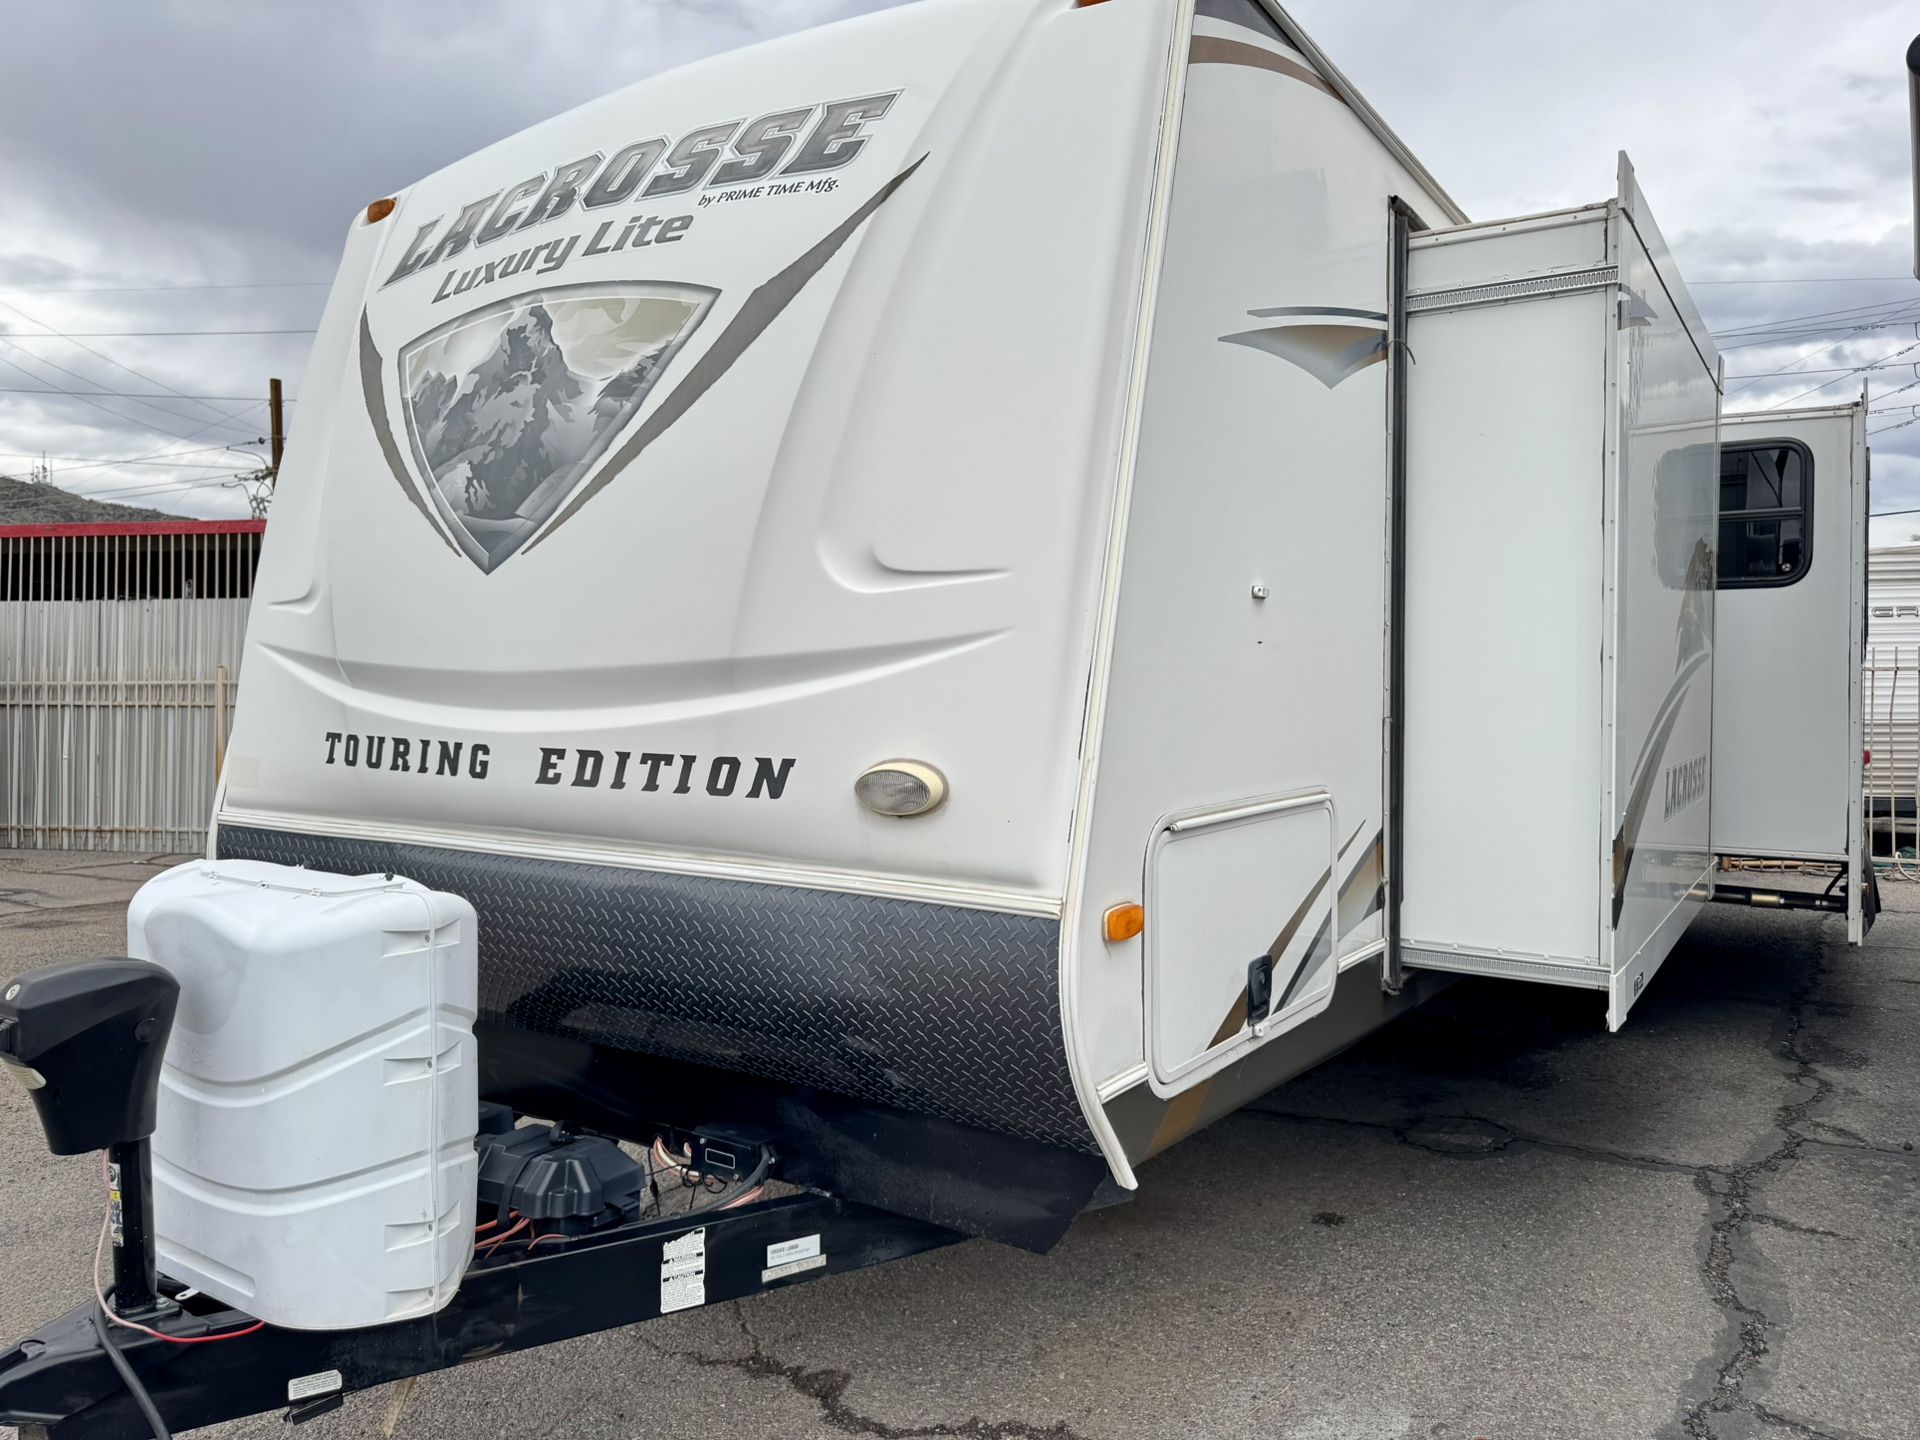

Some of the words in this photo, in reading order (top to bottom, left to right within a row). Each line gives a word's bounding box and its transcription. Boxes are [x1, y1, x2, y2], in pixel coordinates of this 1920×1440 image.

[378, 89, 905, 292] LACROSSE
[698, 195, 716, 209] by
[716, 186, 764, 204] PRIME
[766, 181, 805, 197] TIME
[805, 177, 840, 194] Mfg.
[431, 234, 580, 304] Luxury
[581, 215, 695, 258] Lite
[325, 732, 491, 779] TOURING
[535, 748, 797, 799] EDITION
[1664, 755, 1706, 821] LACROSSE
